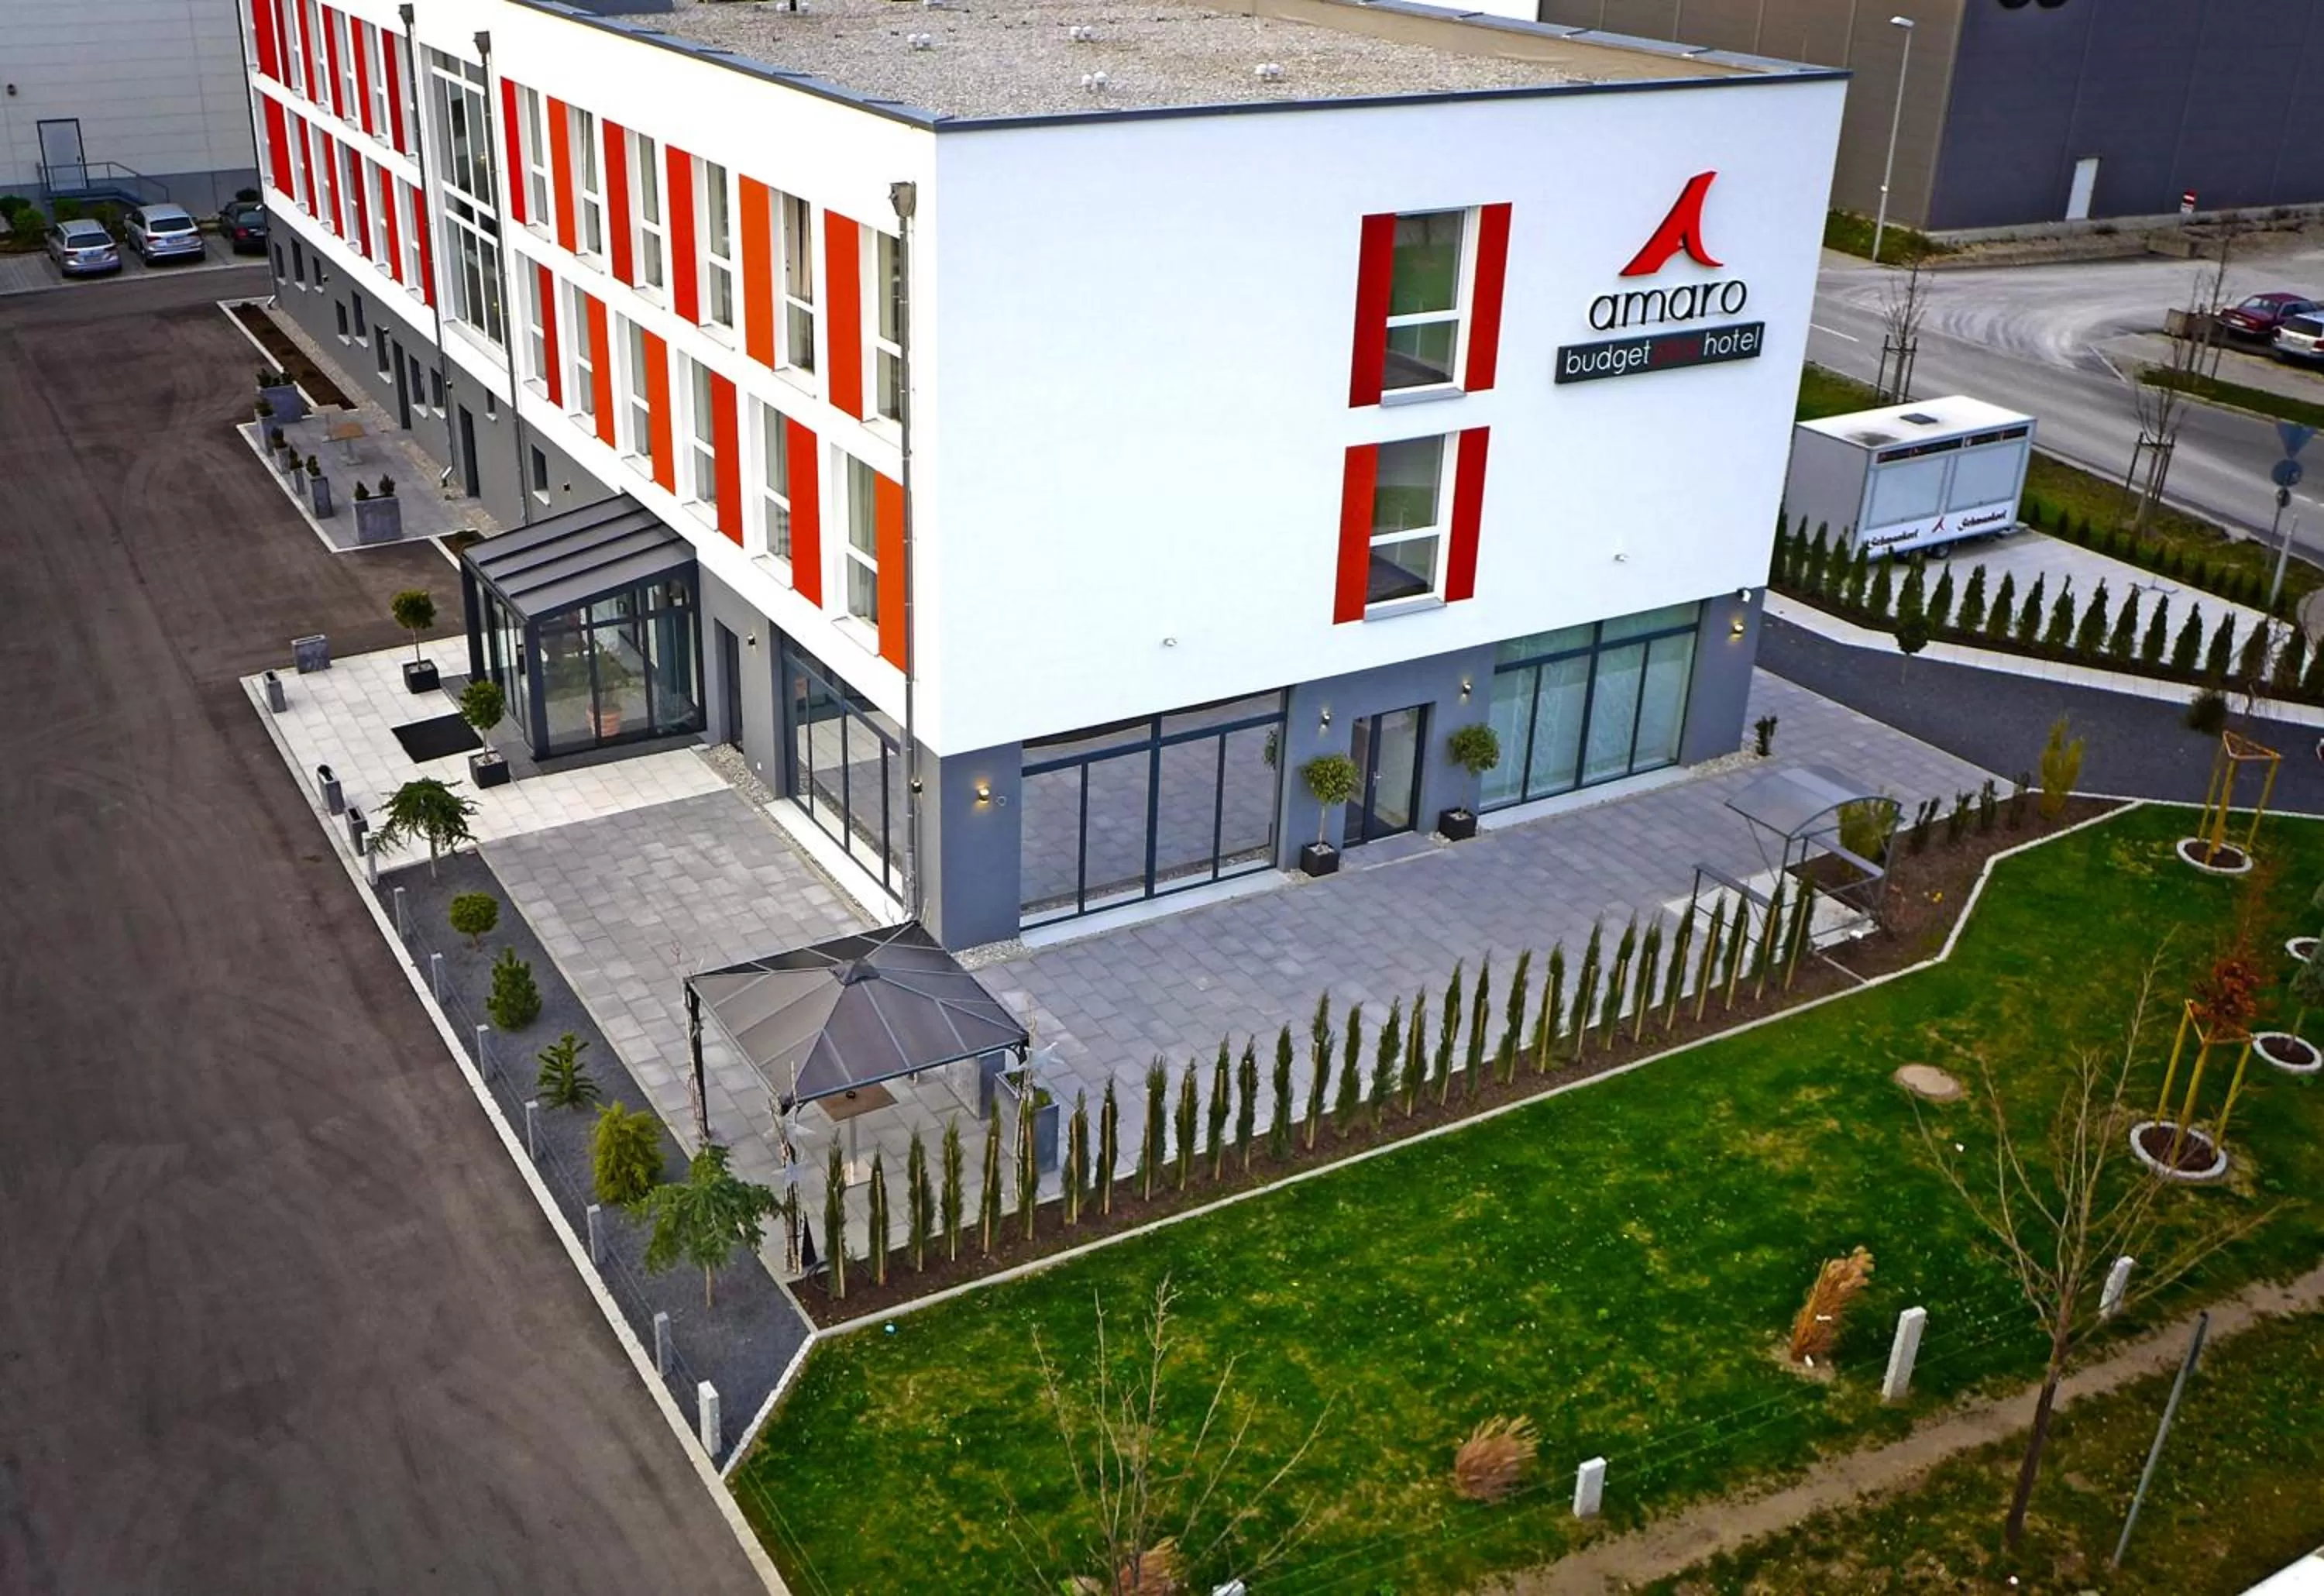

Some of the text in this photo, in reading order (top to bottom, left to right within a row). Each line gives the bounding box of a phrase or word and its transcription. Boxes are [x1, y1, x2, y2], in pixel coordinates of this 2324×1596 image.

[1589, 280, 1747, 330] amaro
[1565, 325, 1761, 375] budget hotel
